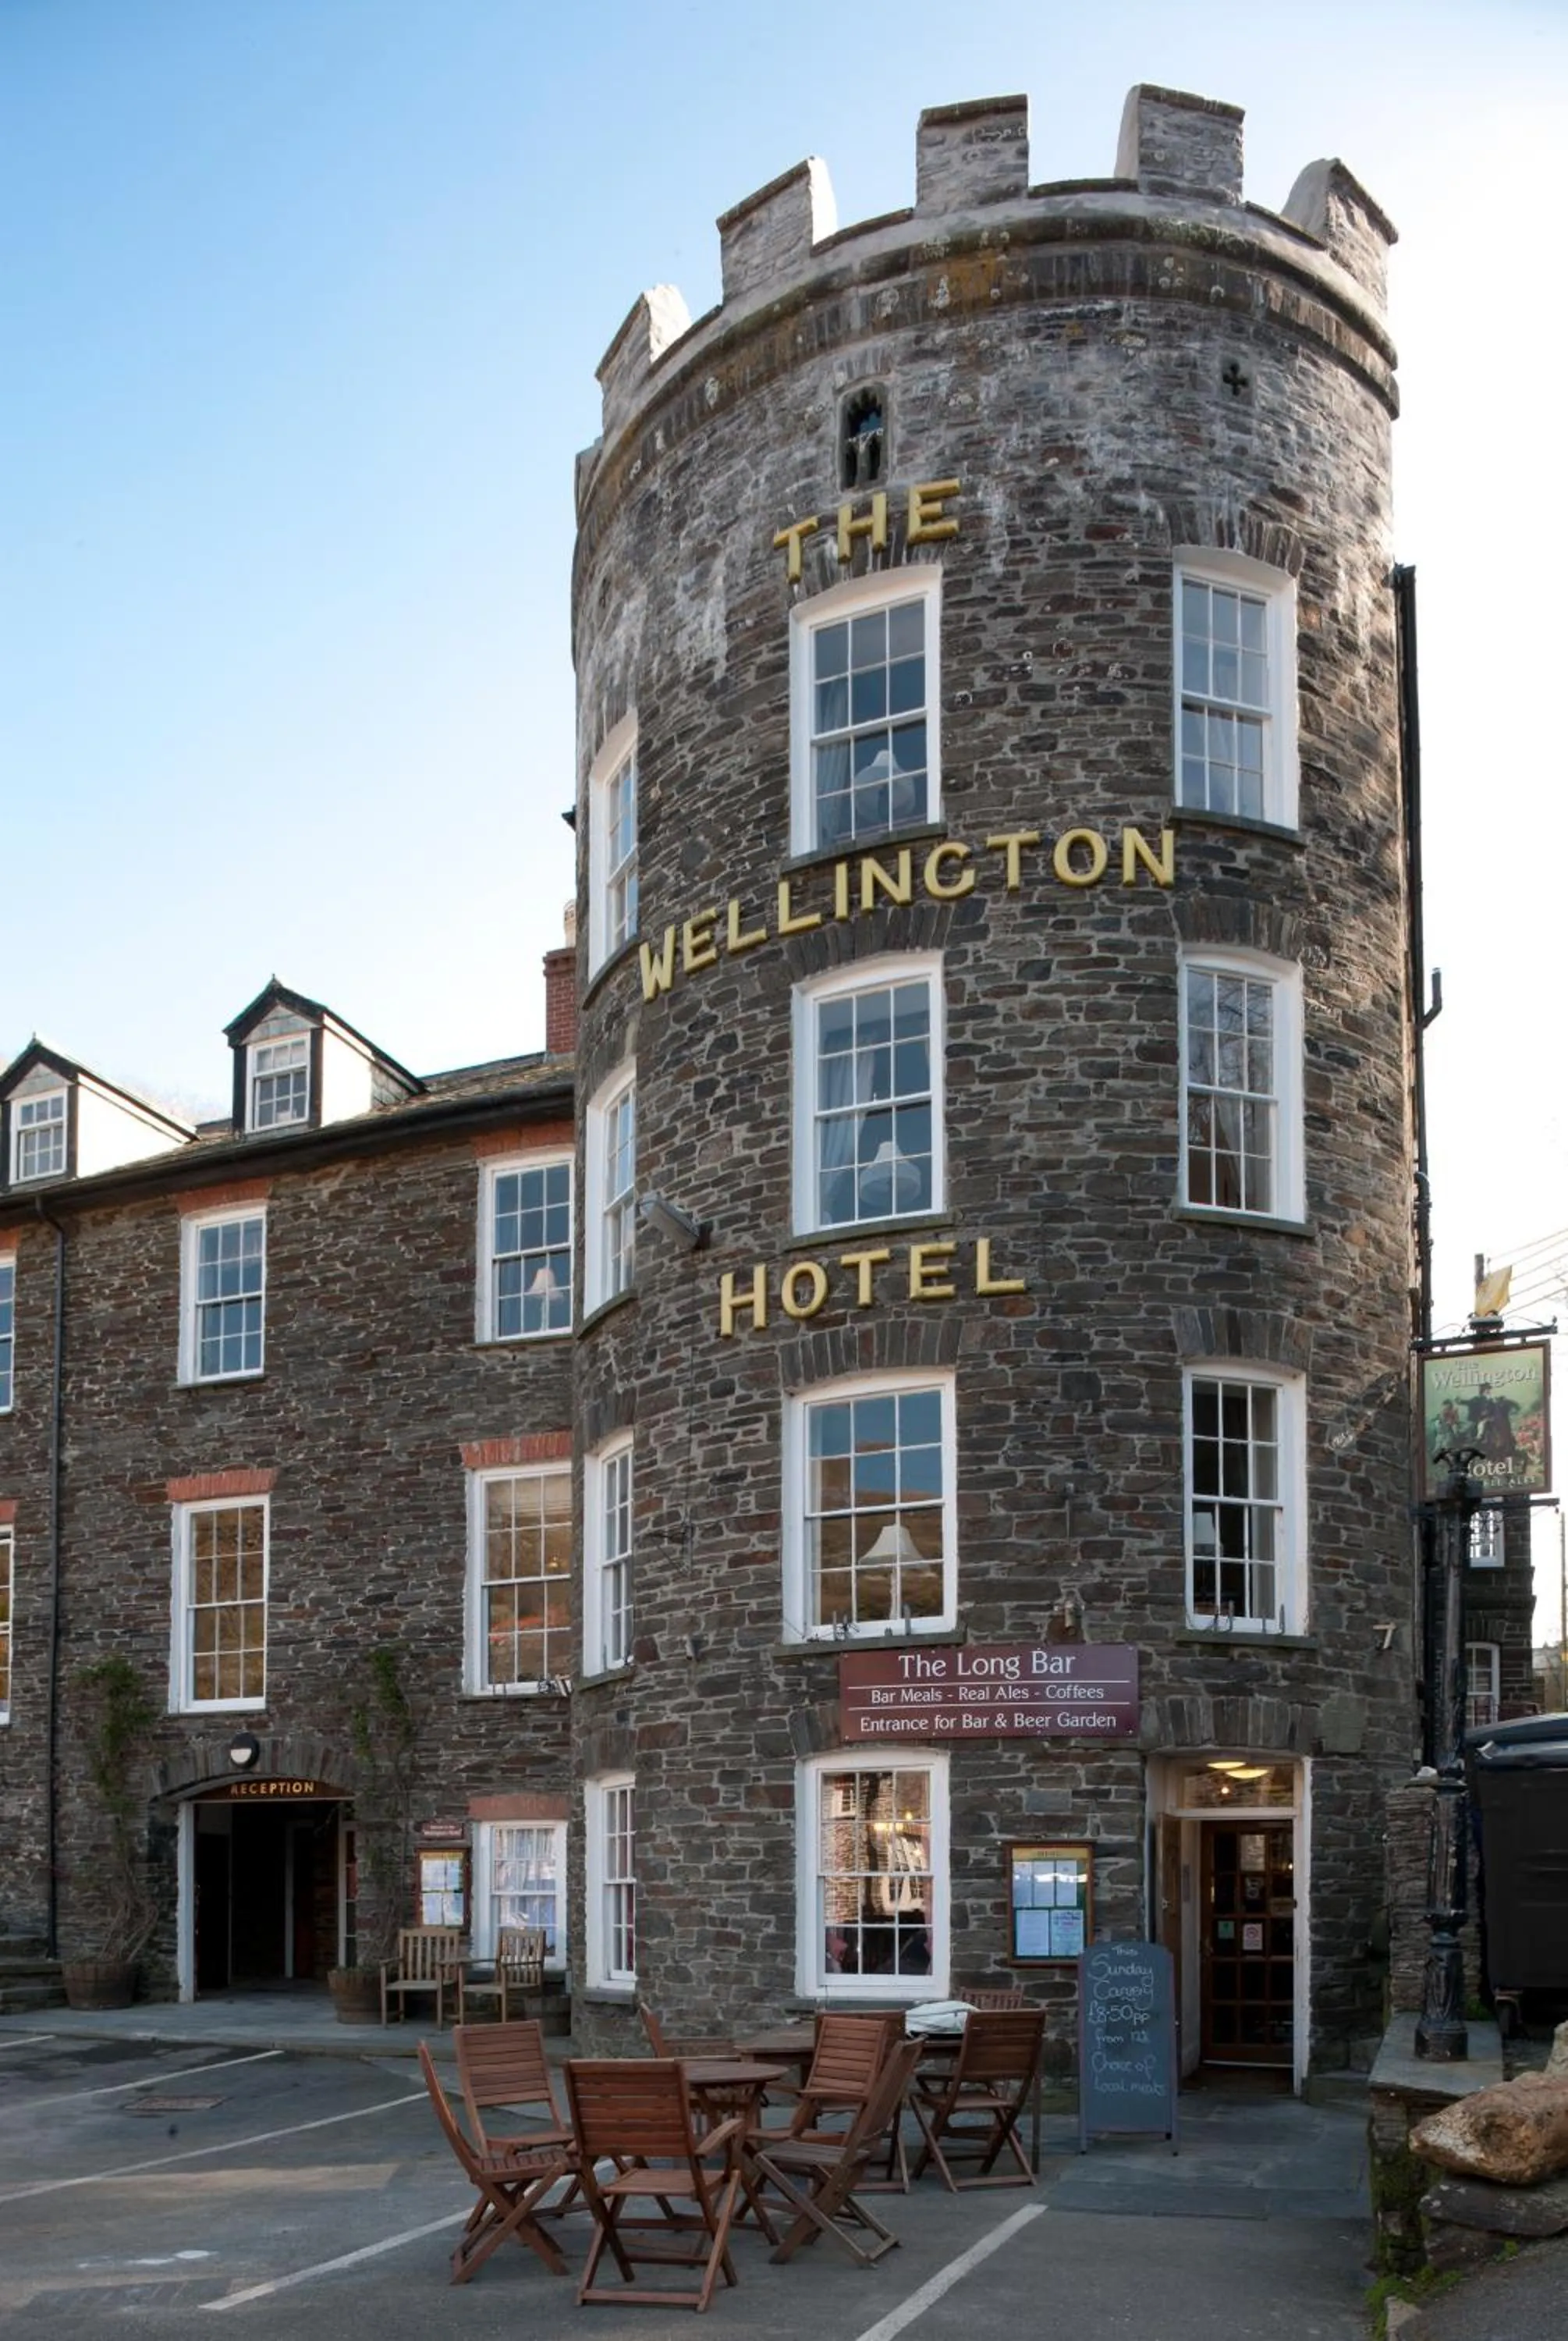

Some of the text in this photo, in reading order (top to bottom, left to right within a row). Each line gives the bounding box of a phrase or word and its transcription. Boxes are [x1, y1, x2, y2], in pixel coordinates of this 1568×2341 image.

[774, 478, 961, 584] THE
[638, 827, 1175, 1003] WELLINGTON
[719, 1238, 1027, 1338] HOTEL
[1433, 1366, 1536, 1390] Wellington
[899, 1650, 1077, 1679] The Long Bar
[871, 1689, 894, 1704] Bar
[900, 1687, 942, 1703] Meals
[959, 1686, 990, 1701] Real
[997, 1686, 1029, 1700] Ales
[1045, 1685, 1105, 1699] Coffees
[860, 1712, 1116, 1732] Entrance for Bar & Beer Garden
[230, 1782, 315, 1795] RECEPTION
[1087, 1952, 1155, 1987] Sunday
[1134, 2055, 1156, 2080] of
